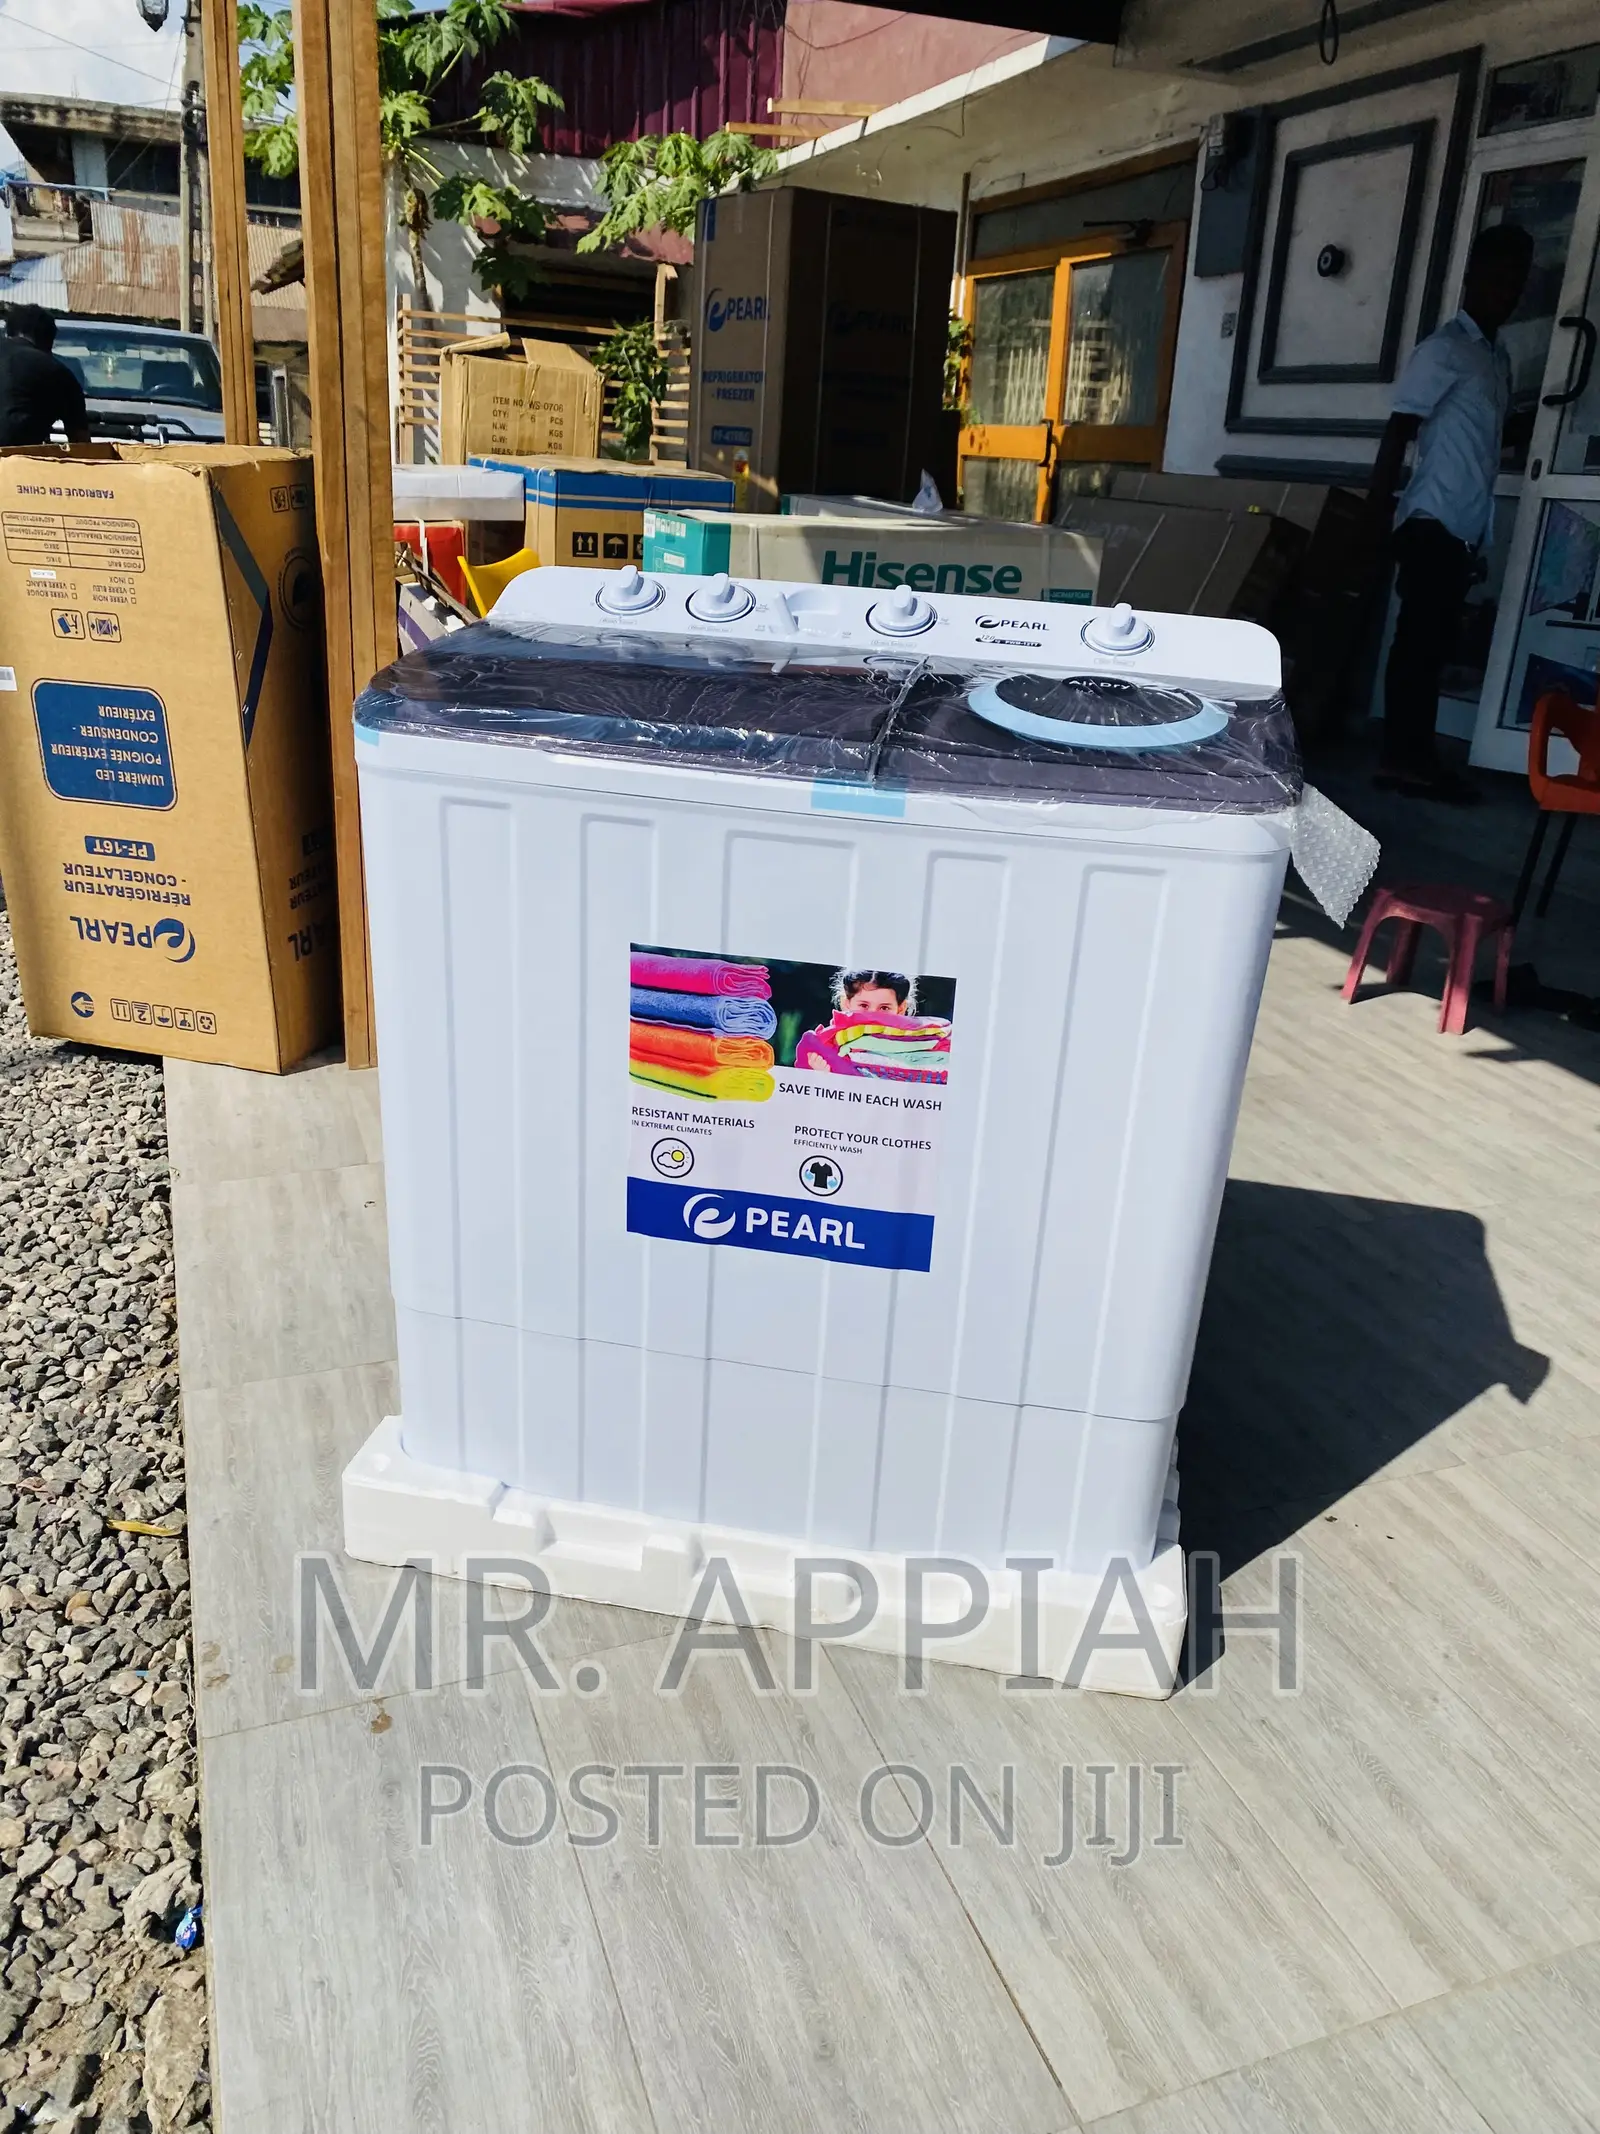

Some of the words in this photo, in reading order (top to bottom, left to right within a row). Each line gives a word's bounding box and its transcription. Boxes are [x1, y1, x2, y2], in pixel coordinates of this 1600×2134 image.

[492, 396, 510, 405] ITEM
[530, 414, 536, 423] 6
[550, 416, 564, 426] PCS
[549, 429, 563, 438] KGS
[547, 441, 563, 450] KGS
[16, 484, 47, 495] CHINE
[49, 486, 63, 496] EN
[65, 487, 115, 499] FABRIQUE
[821, 550, 1023, 595] Hisense
[26, 579, 48, 588] BLANC
[48, 582, 68, 590] VERRE
[109, 576, 126, 584] INOX
[27, 589, 49, 598] ROUGE
[49, 590, 69, 599] VERRE
[92, 584, 108, 593] BLEU
[108, 586, 128, 594] VERRE
[92, 594, 109, 602] NOIR
[109, 596, 129, 604] VERRE
[1000, 619, 1050, 631] PEARL
[1100, 681, 1131, 690] Dry
[98, 705, 156, 723] EXTÉRIEUR
[80, 725, 159, 744] CONDENSUER
[50, 743, 107, 760] EXTÉRIEUR
[110, 749, 162, 765] POIGNÉE
[95, 769, 116, 782] LED
[118, 771, 165, 787] LUMIÈRE
[93, 839, 149, 859] PF-16T
[63, 862, 178, 887] CONGELATEUR
[63, 879, 192, 908] RÉFRIGÉRATEUR
[69, 915, 154, 949] PEARL
[779, 1082, 811, 1096] SAVE
[814, 1086, 845, 1101] TIME
[848, 1092, 862, 1103] IN
[865, 1094, 899, 1108] EACH
[903, 1098, 942, 1111] WASH
[631, 1106, 690, 1122] RESISTANT
[692, 1114, 755, 1129] MATERIALS
[631, 1119, 640, 1127] IN
[641, 1120, 675, 1132] EXTREME
[676, 1125, 713, 1136] CLIMATES
[794, 1125, 844, 1141] PROTECT
[846, 1133, 879, 1146] YOUR
[881, 1137, 932, 1150] CLOTHES
[793, 1138, 838, 1151] EFFICIENTLY
[839, 1145, 863, 1155] WASH
[745, 1206, 866, 1251] PEARL
